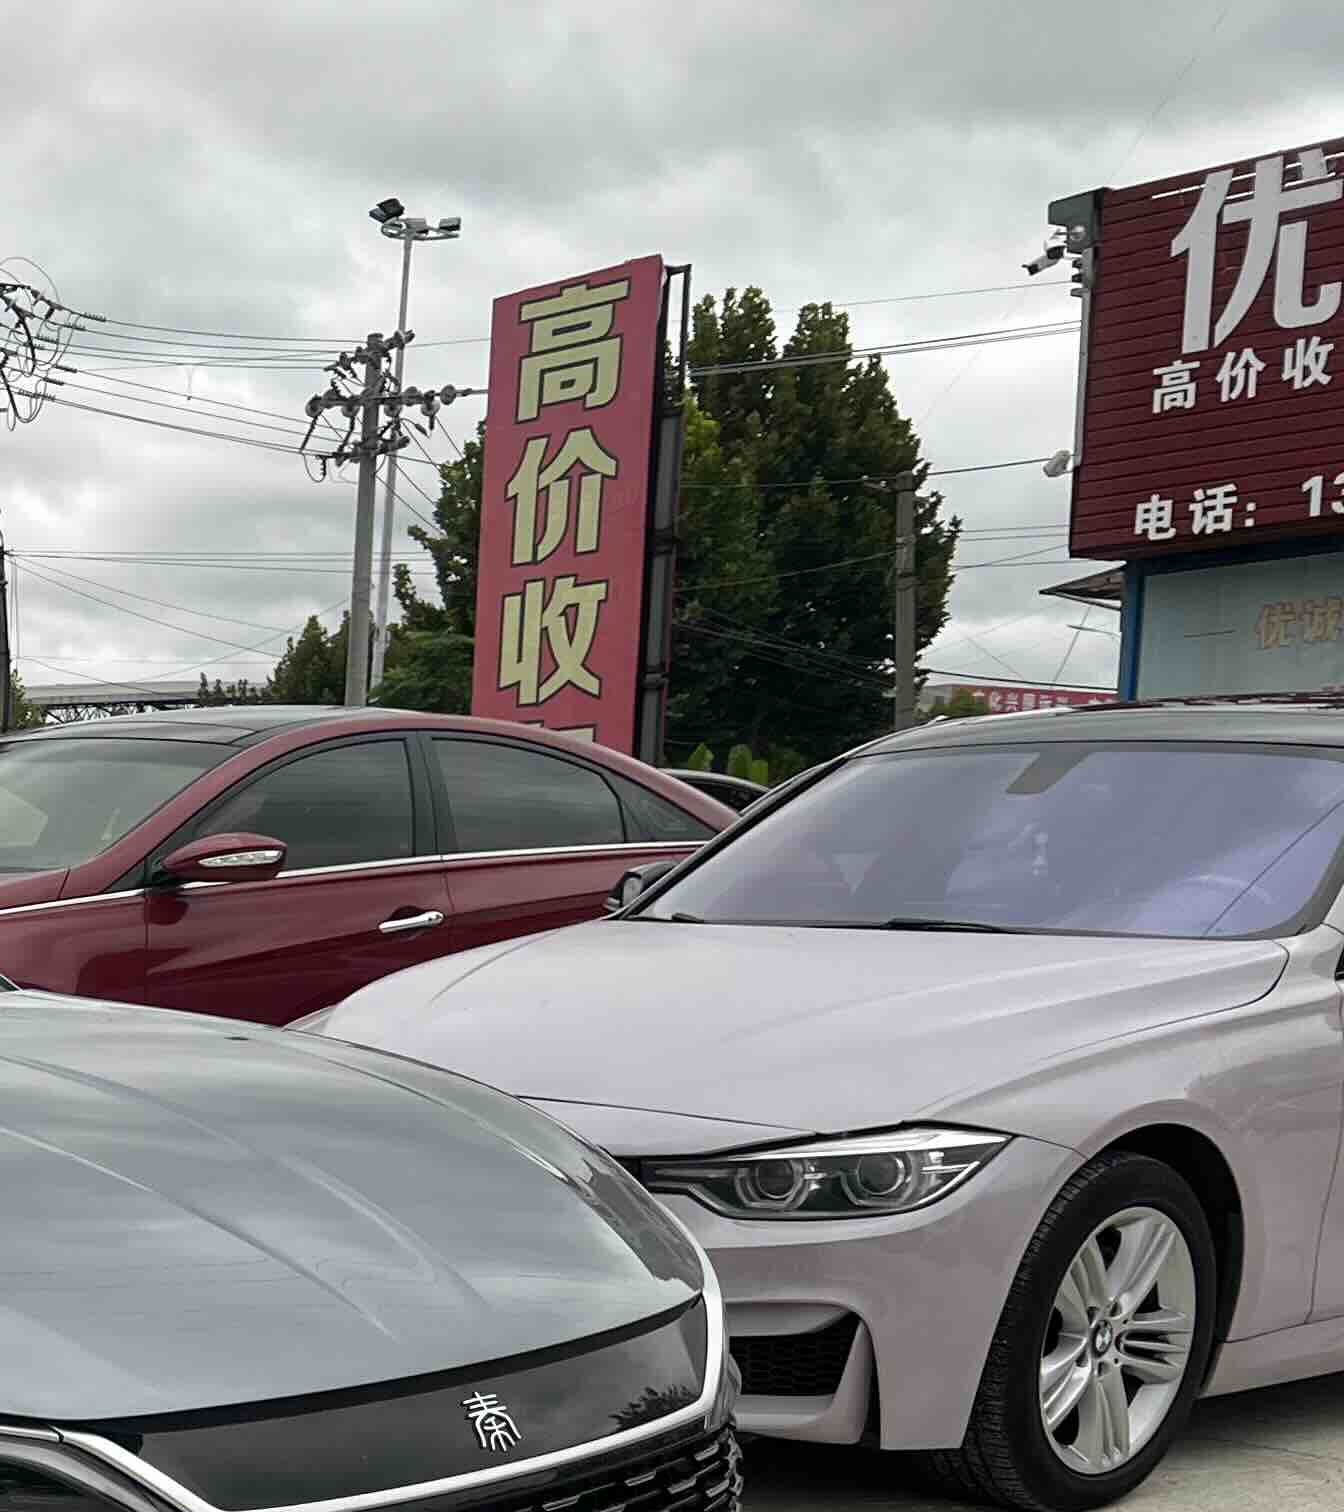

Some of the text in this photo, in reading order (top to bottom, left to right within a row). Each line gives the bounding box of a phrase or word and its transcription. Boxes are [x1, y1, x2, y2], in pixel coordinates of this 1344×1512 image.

[1170, 146, 1344, 354] 优
[1151, 335, 1335, 414] 高价收
[498, 277, 630, 743] 高价收
[462, 1391, 522, 1452] 秦
